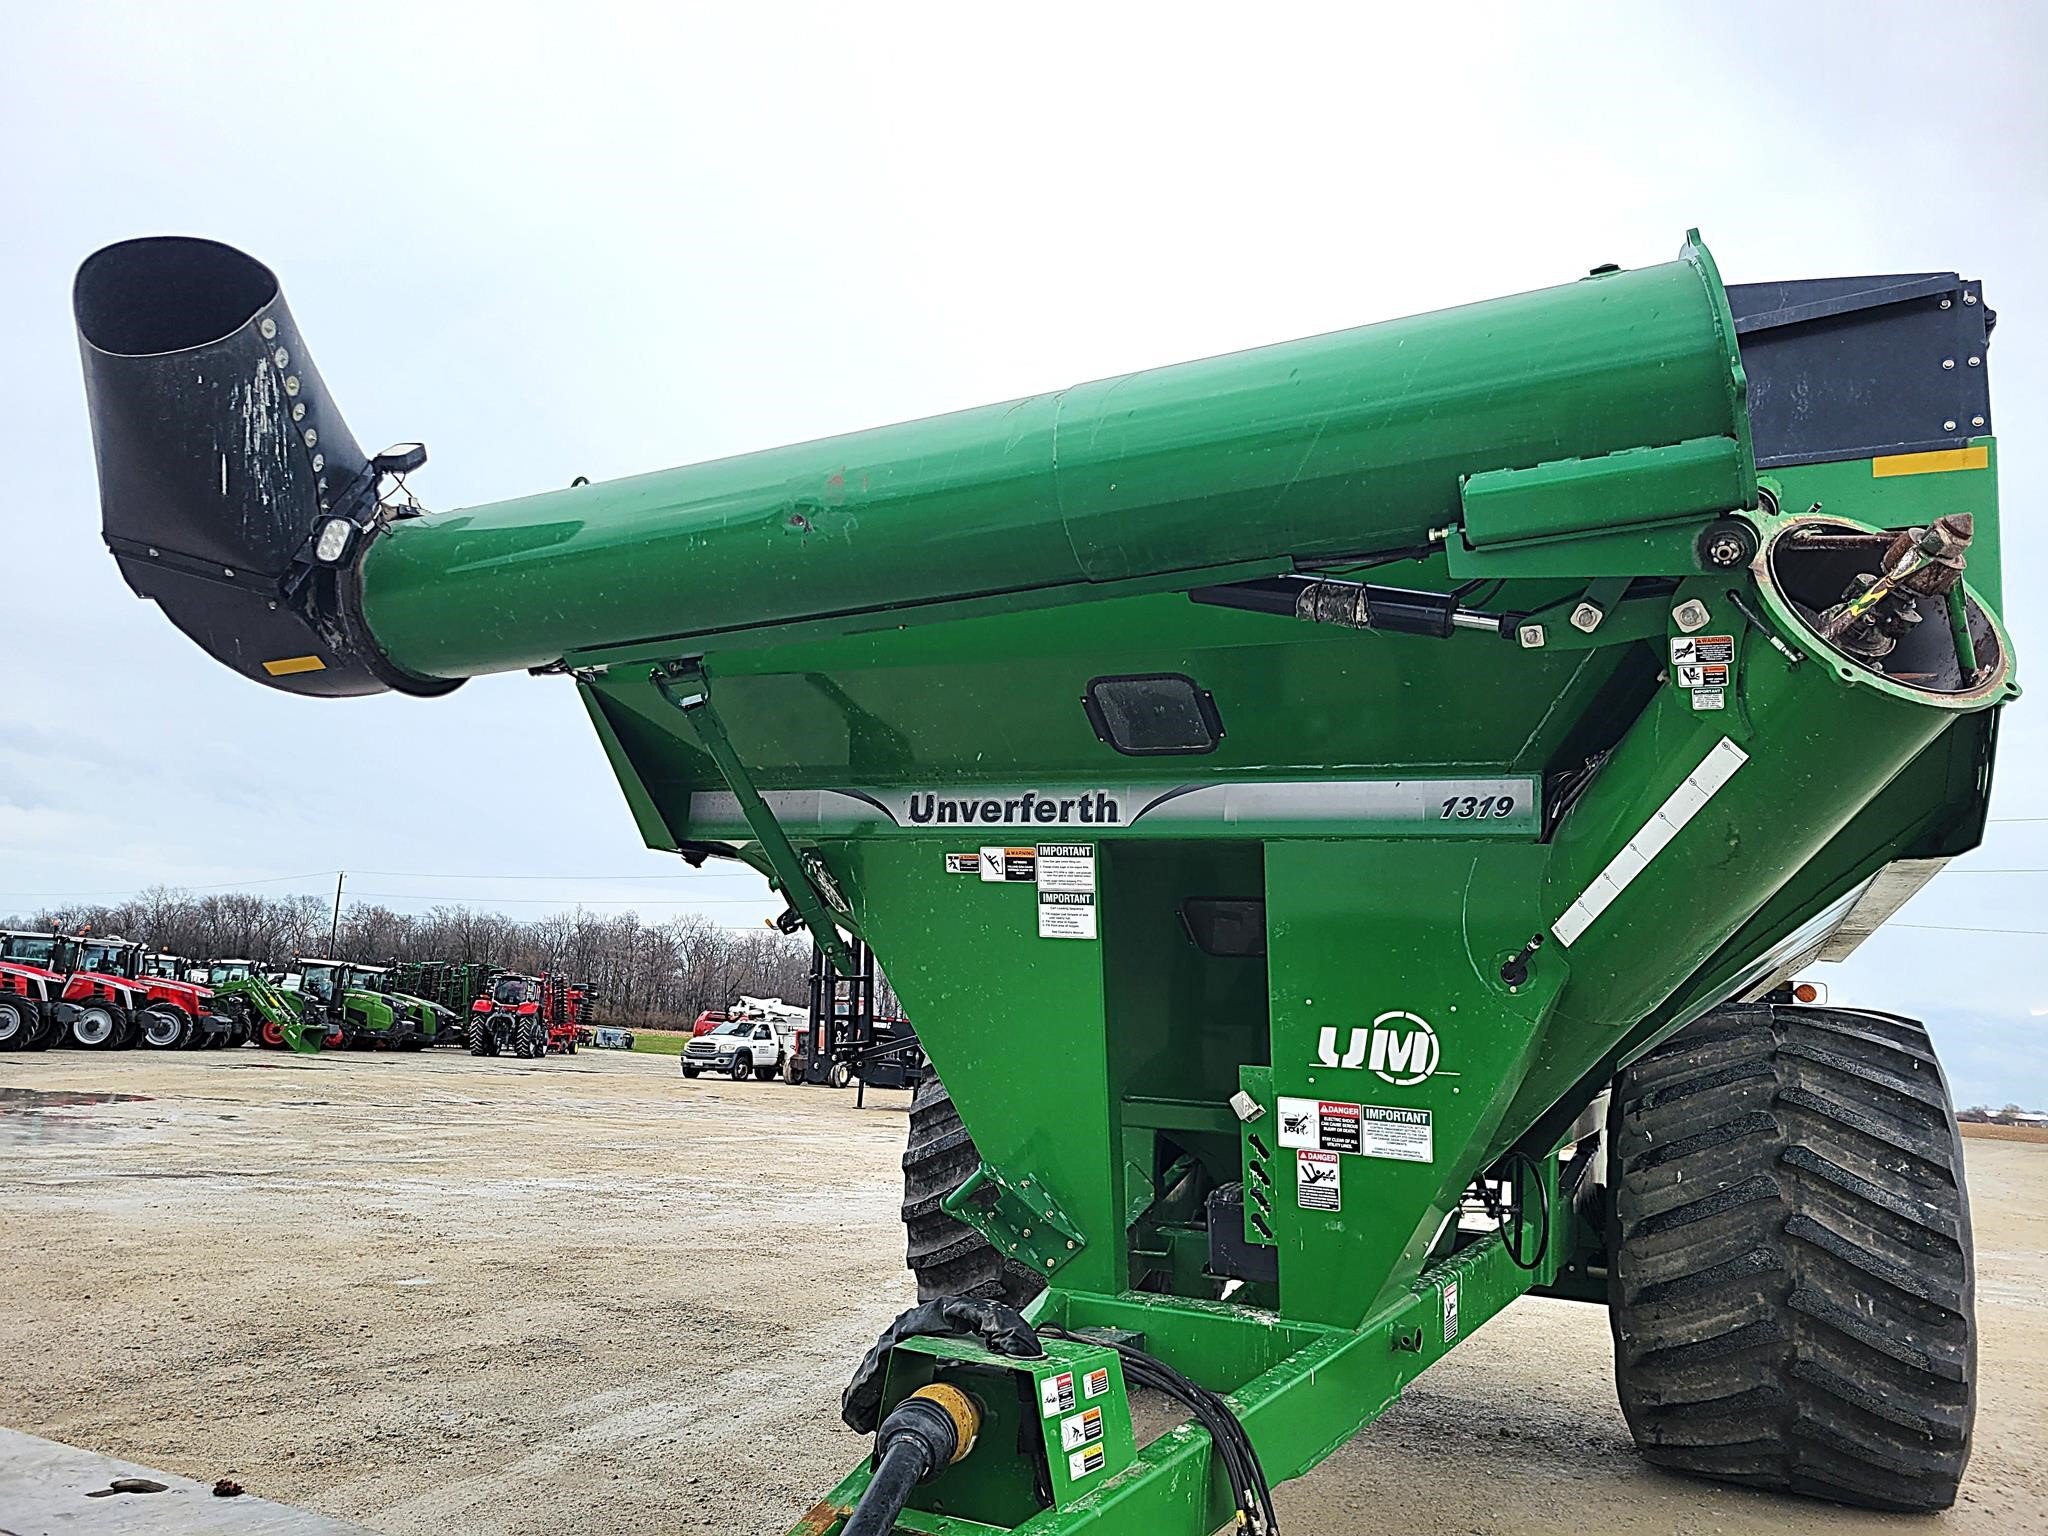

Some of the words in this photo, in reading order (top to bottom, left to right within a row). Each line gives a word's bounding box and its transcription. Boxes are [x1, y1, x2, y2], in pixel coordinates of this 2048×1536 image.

[909, 790, 1119, 823] Unverferth
[1440, 796, 1515, 819] 1319
[1039, 846, 1091, 856] IMPORTANT
[1042, 893, 1091, 904] IMPORTANT
[1328, 1105, 1359, 1116] DANGER
[1366, 1108, 1428, 1124] IMPORTANT
[1308, 1152, 1337, 1162] DANGER
